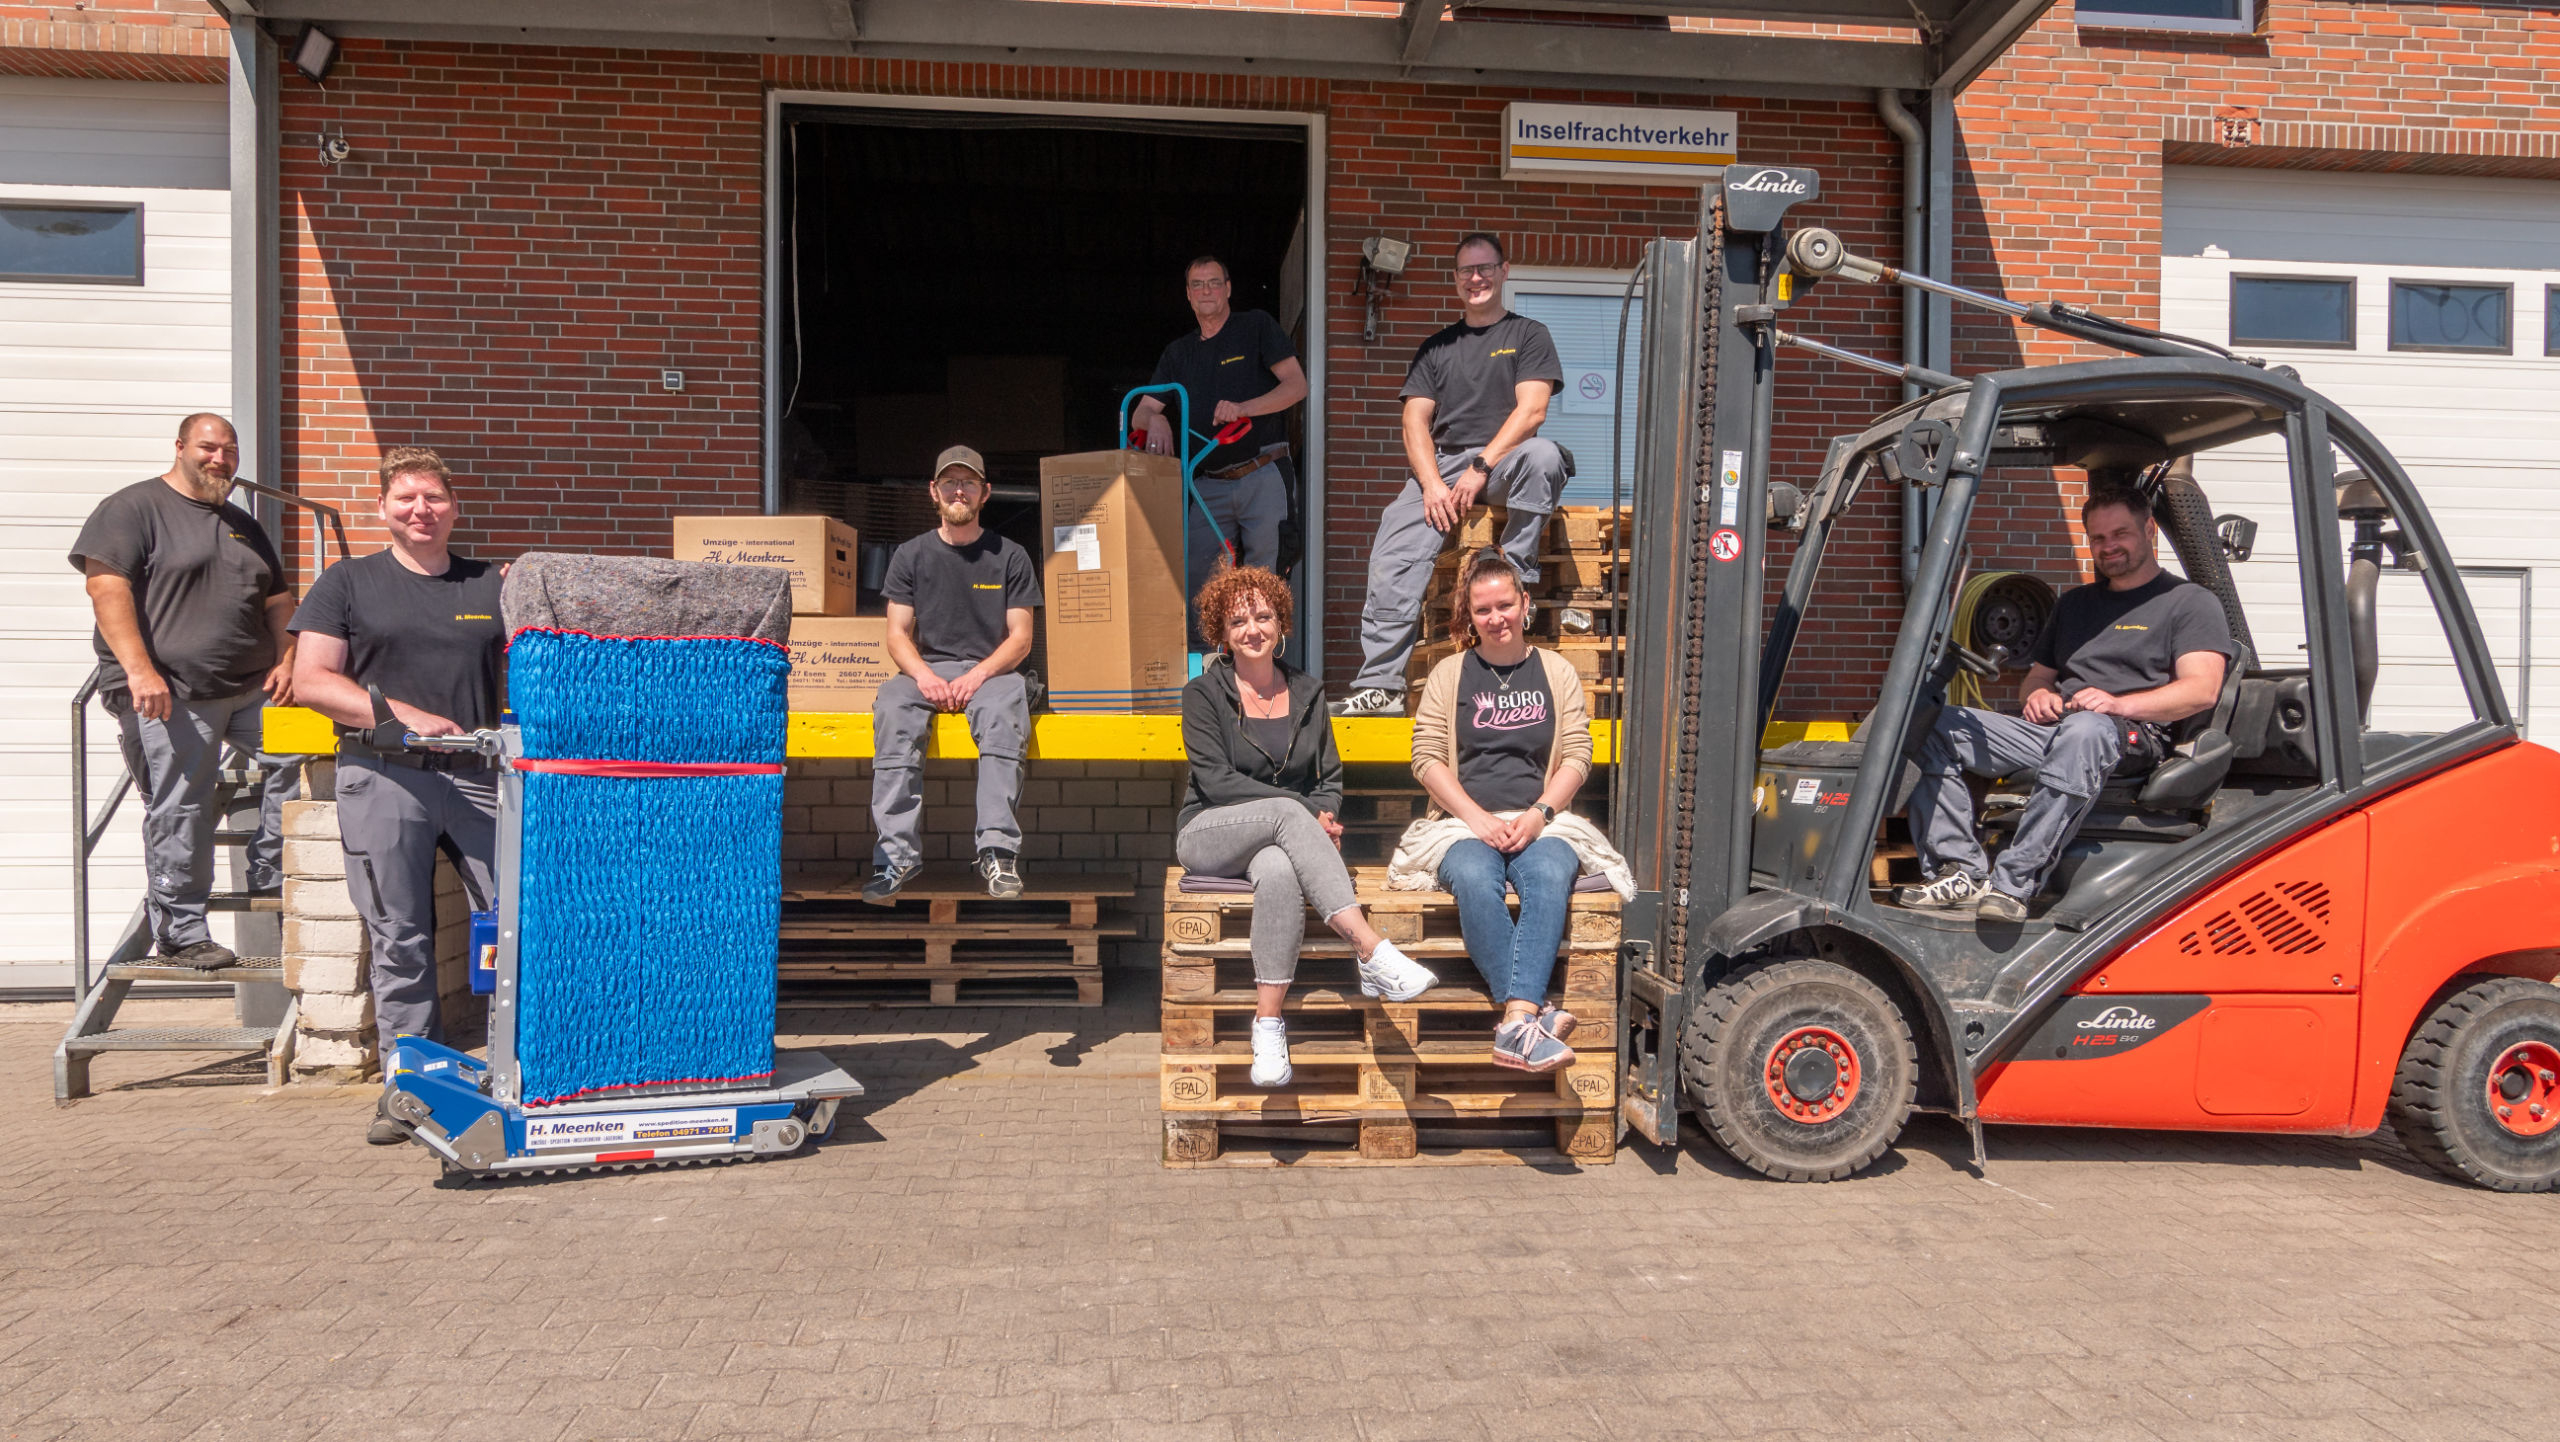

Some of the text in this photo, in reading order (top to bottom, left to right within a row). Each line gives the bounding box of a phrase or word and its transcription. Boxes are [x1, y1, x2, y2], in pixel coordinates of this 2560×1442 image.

[1517, 119, 1730, 147] Inselfrachtverkehr
[1729, 169, 1807, 194] Linde
[703, 538, 738, 547] Umzüge
[702, 551, 795, 564] H. Meenken
[787, 640, 823, 648] Umzüge
[789, 652, 880, 665] H. Meenken
[1498, 690, 1545, 709] BÜRO
[1472, 704, 1547, 730] Queen
[1179, 921, 1206, 935] EPAL
[2077, 1006, 2156, 1029] Linde
[1174, 1082, 1202, 1095] EPAL
[1576, 1080, 1603, 1092] EPAL
[530, 1121, 624, 1136] H. Meenken
[638, 1117, 729, 1128] www.spedition-meenken.de
[636, 1130, 671, 1139] Telefon
[672, 1128, 700, 1136] 04971
[708, 1126, 730, 1134] 7495
